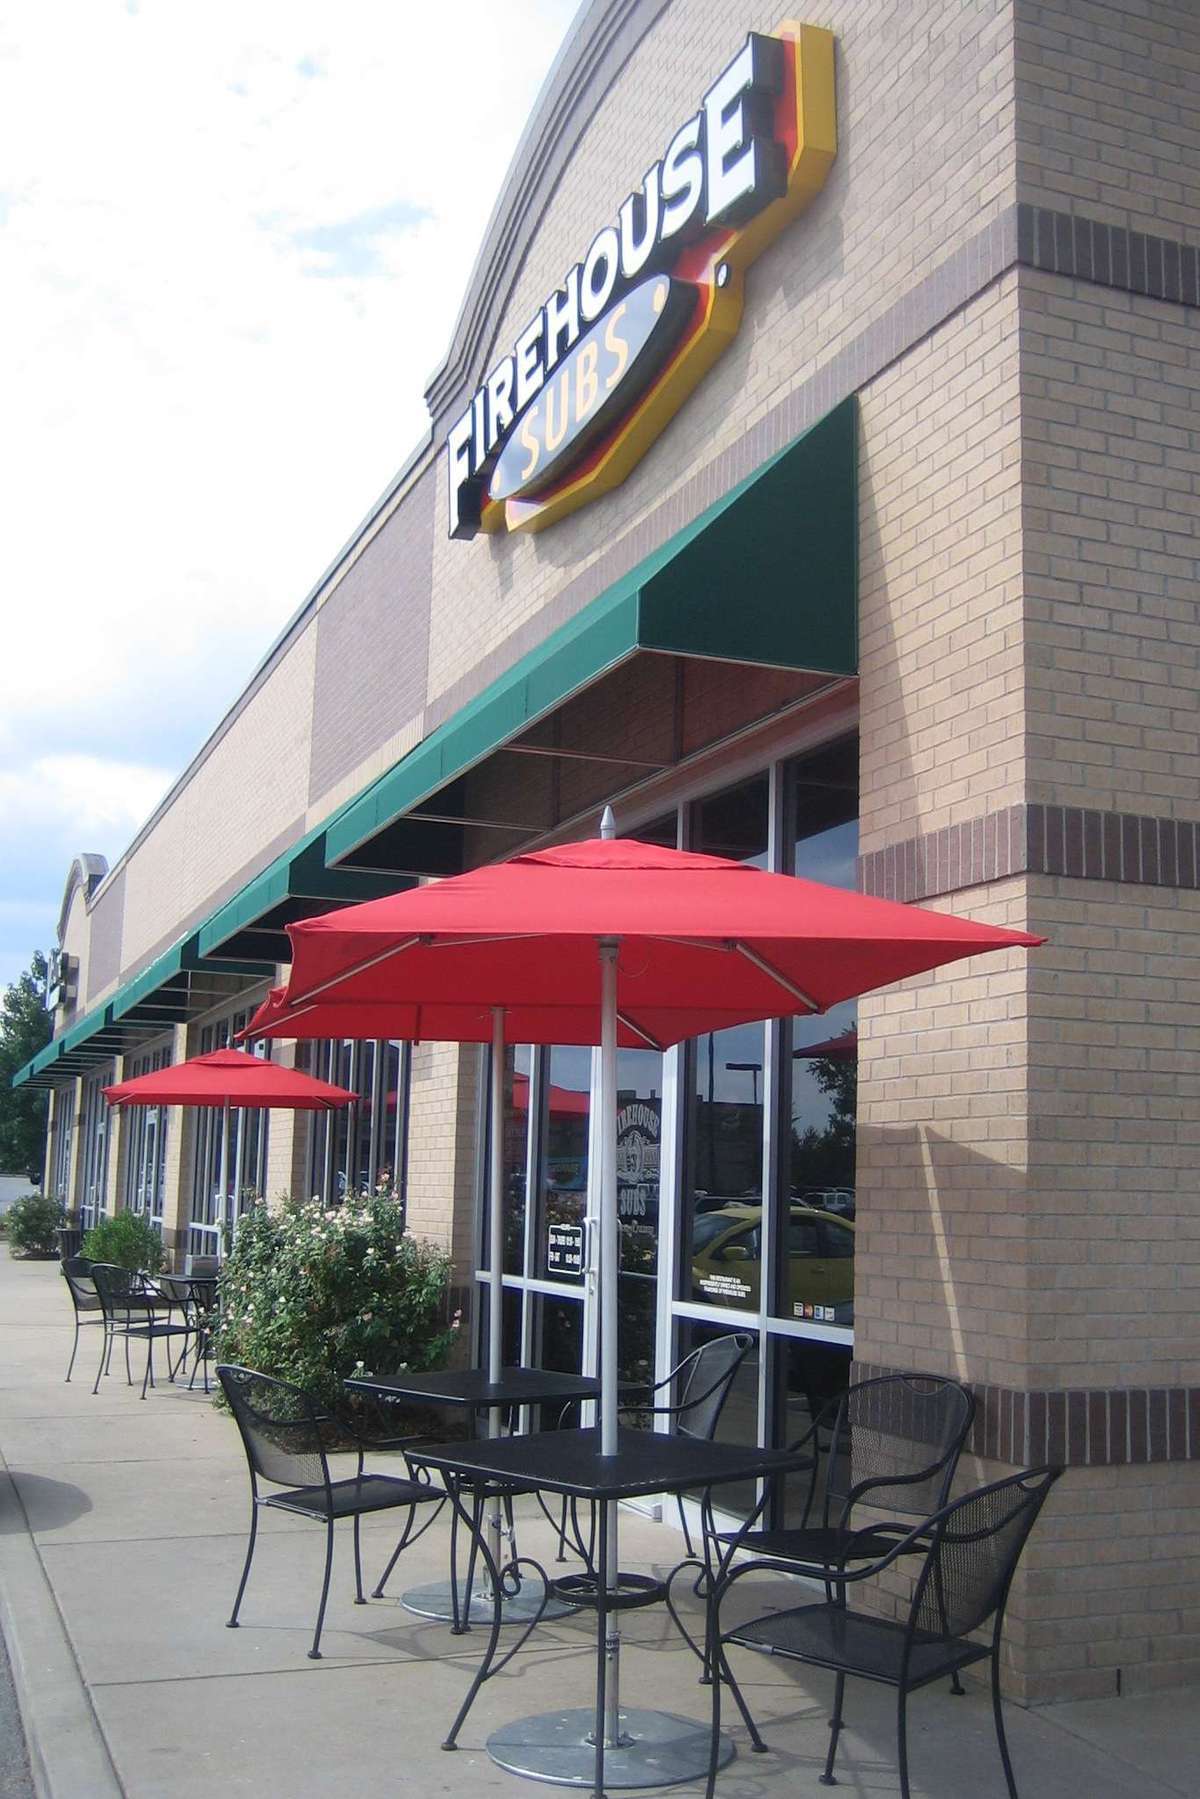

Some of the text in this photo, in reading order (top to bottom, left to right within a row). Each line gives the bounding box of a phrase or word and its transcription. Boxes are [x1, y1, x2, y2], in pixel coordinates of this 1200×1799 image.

[447, 31, 762, 540] FIREHOUSE
[520, 304, 630, 480] SUBS
[616, 1103, 660, 1139] IREHOUSE
